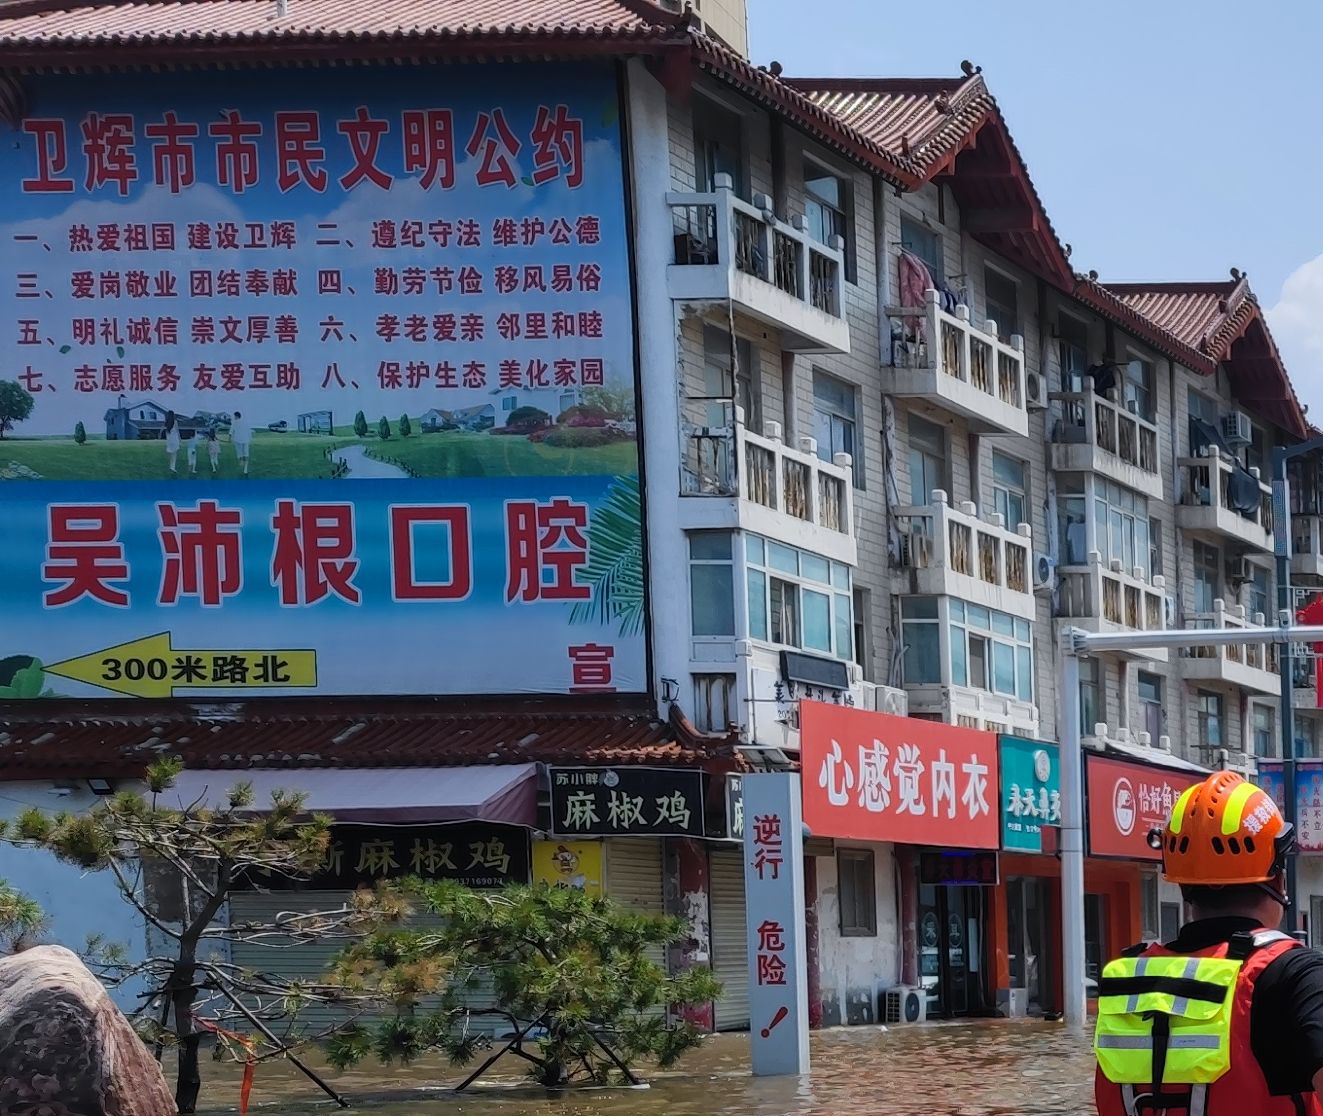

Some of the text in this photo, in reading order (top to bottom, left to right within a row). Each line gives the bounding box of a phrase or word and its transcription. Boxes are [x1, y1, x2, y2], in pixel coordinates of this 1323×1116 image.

[22, 104, 585, 195] 卫辉市市民文明公约
[13, 216, 601, 253] 一、热爱祖国 建设卫辉 二、遵纪守法 维护公德
[15, 264, 602, 300] 三、爱岗敬业 团结奉献 四、勤劳节俭 移风易俗
[17, 310, 604, 348] 五、明礼诚信 崇文厚善 六、孝老爱亲 邻里和睦
[18, 358, 605, 393] 七、志愿服务 友爱互助 八、保护生态 美化家园
[43, 497, 592, 607] 吴沛根口腔
[102, 654, 291, 685] 300米路北
[568, 643, 617, 693] 宣
[556, 773, 599, 786] 苏小胖
[819, 739, 990, 820] 心感觉内衣
[562, 790, 691, 830] 麻椒鸡
[753, 814, 783, 880] 逆行
